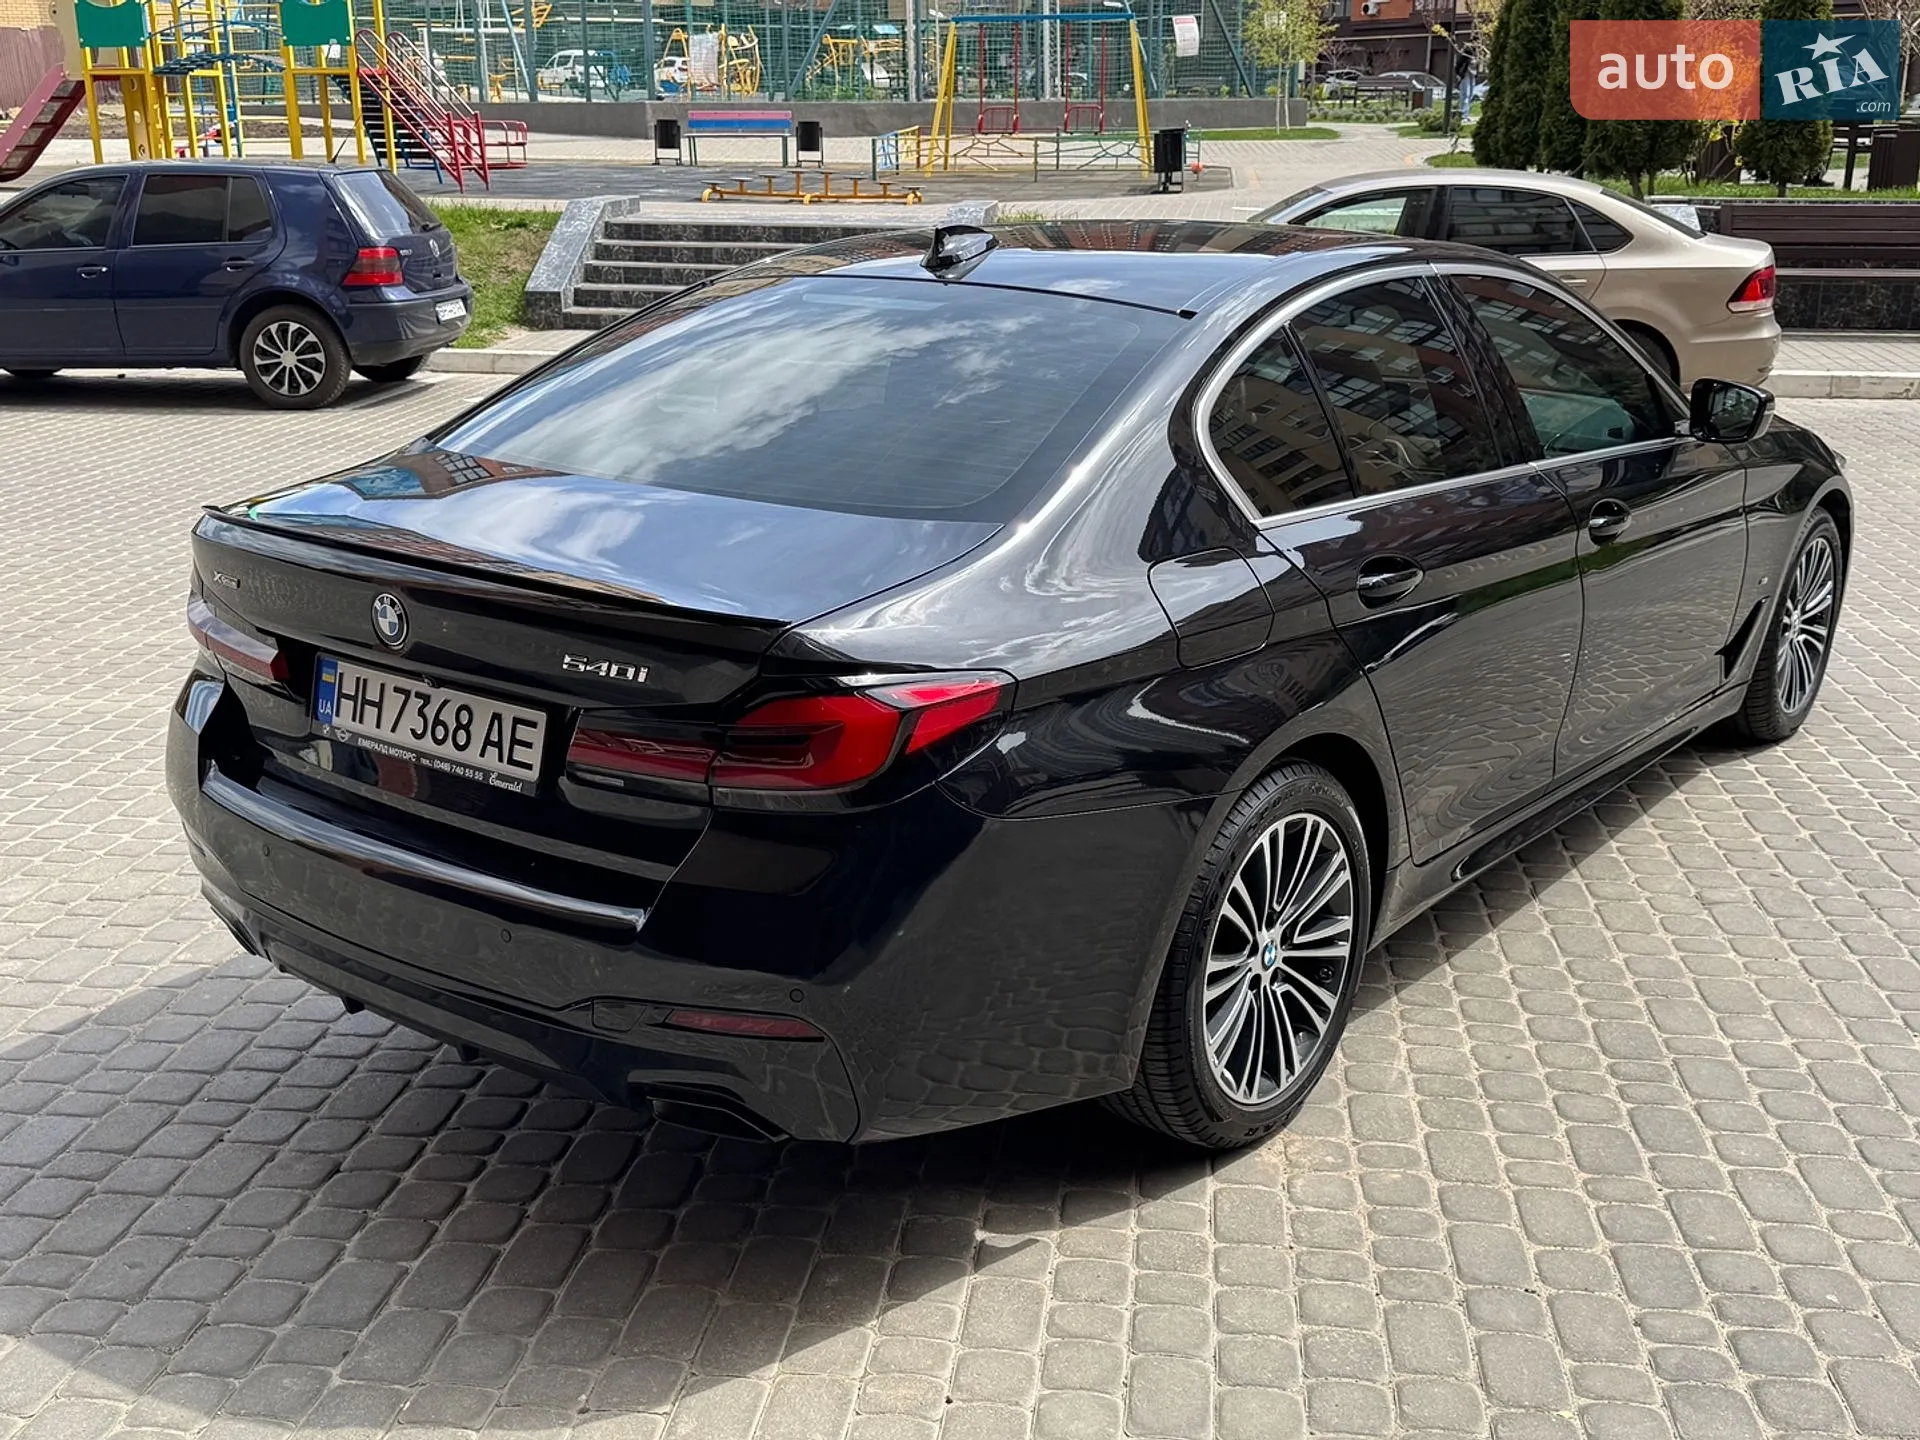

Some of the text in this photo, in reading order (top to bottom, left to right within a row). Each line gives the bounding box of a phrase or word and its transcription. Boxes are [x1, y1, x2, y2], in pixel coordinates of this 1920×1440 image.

[562, 654, 649, 683] 540i
[318, 701, 332, 715] UA
[390, 686, 474, 752] 7368
[478, 711, 539, 771] AE
[388, 747, 418, 762] МОТОРС
[489, 771, 524, 793] Emerald
